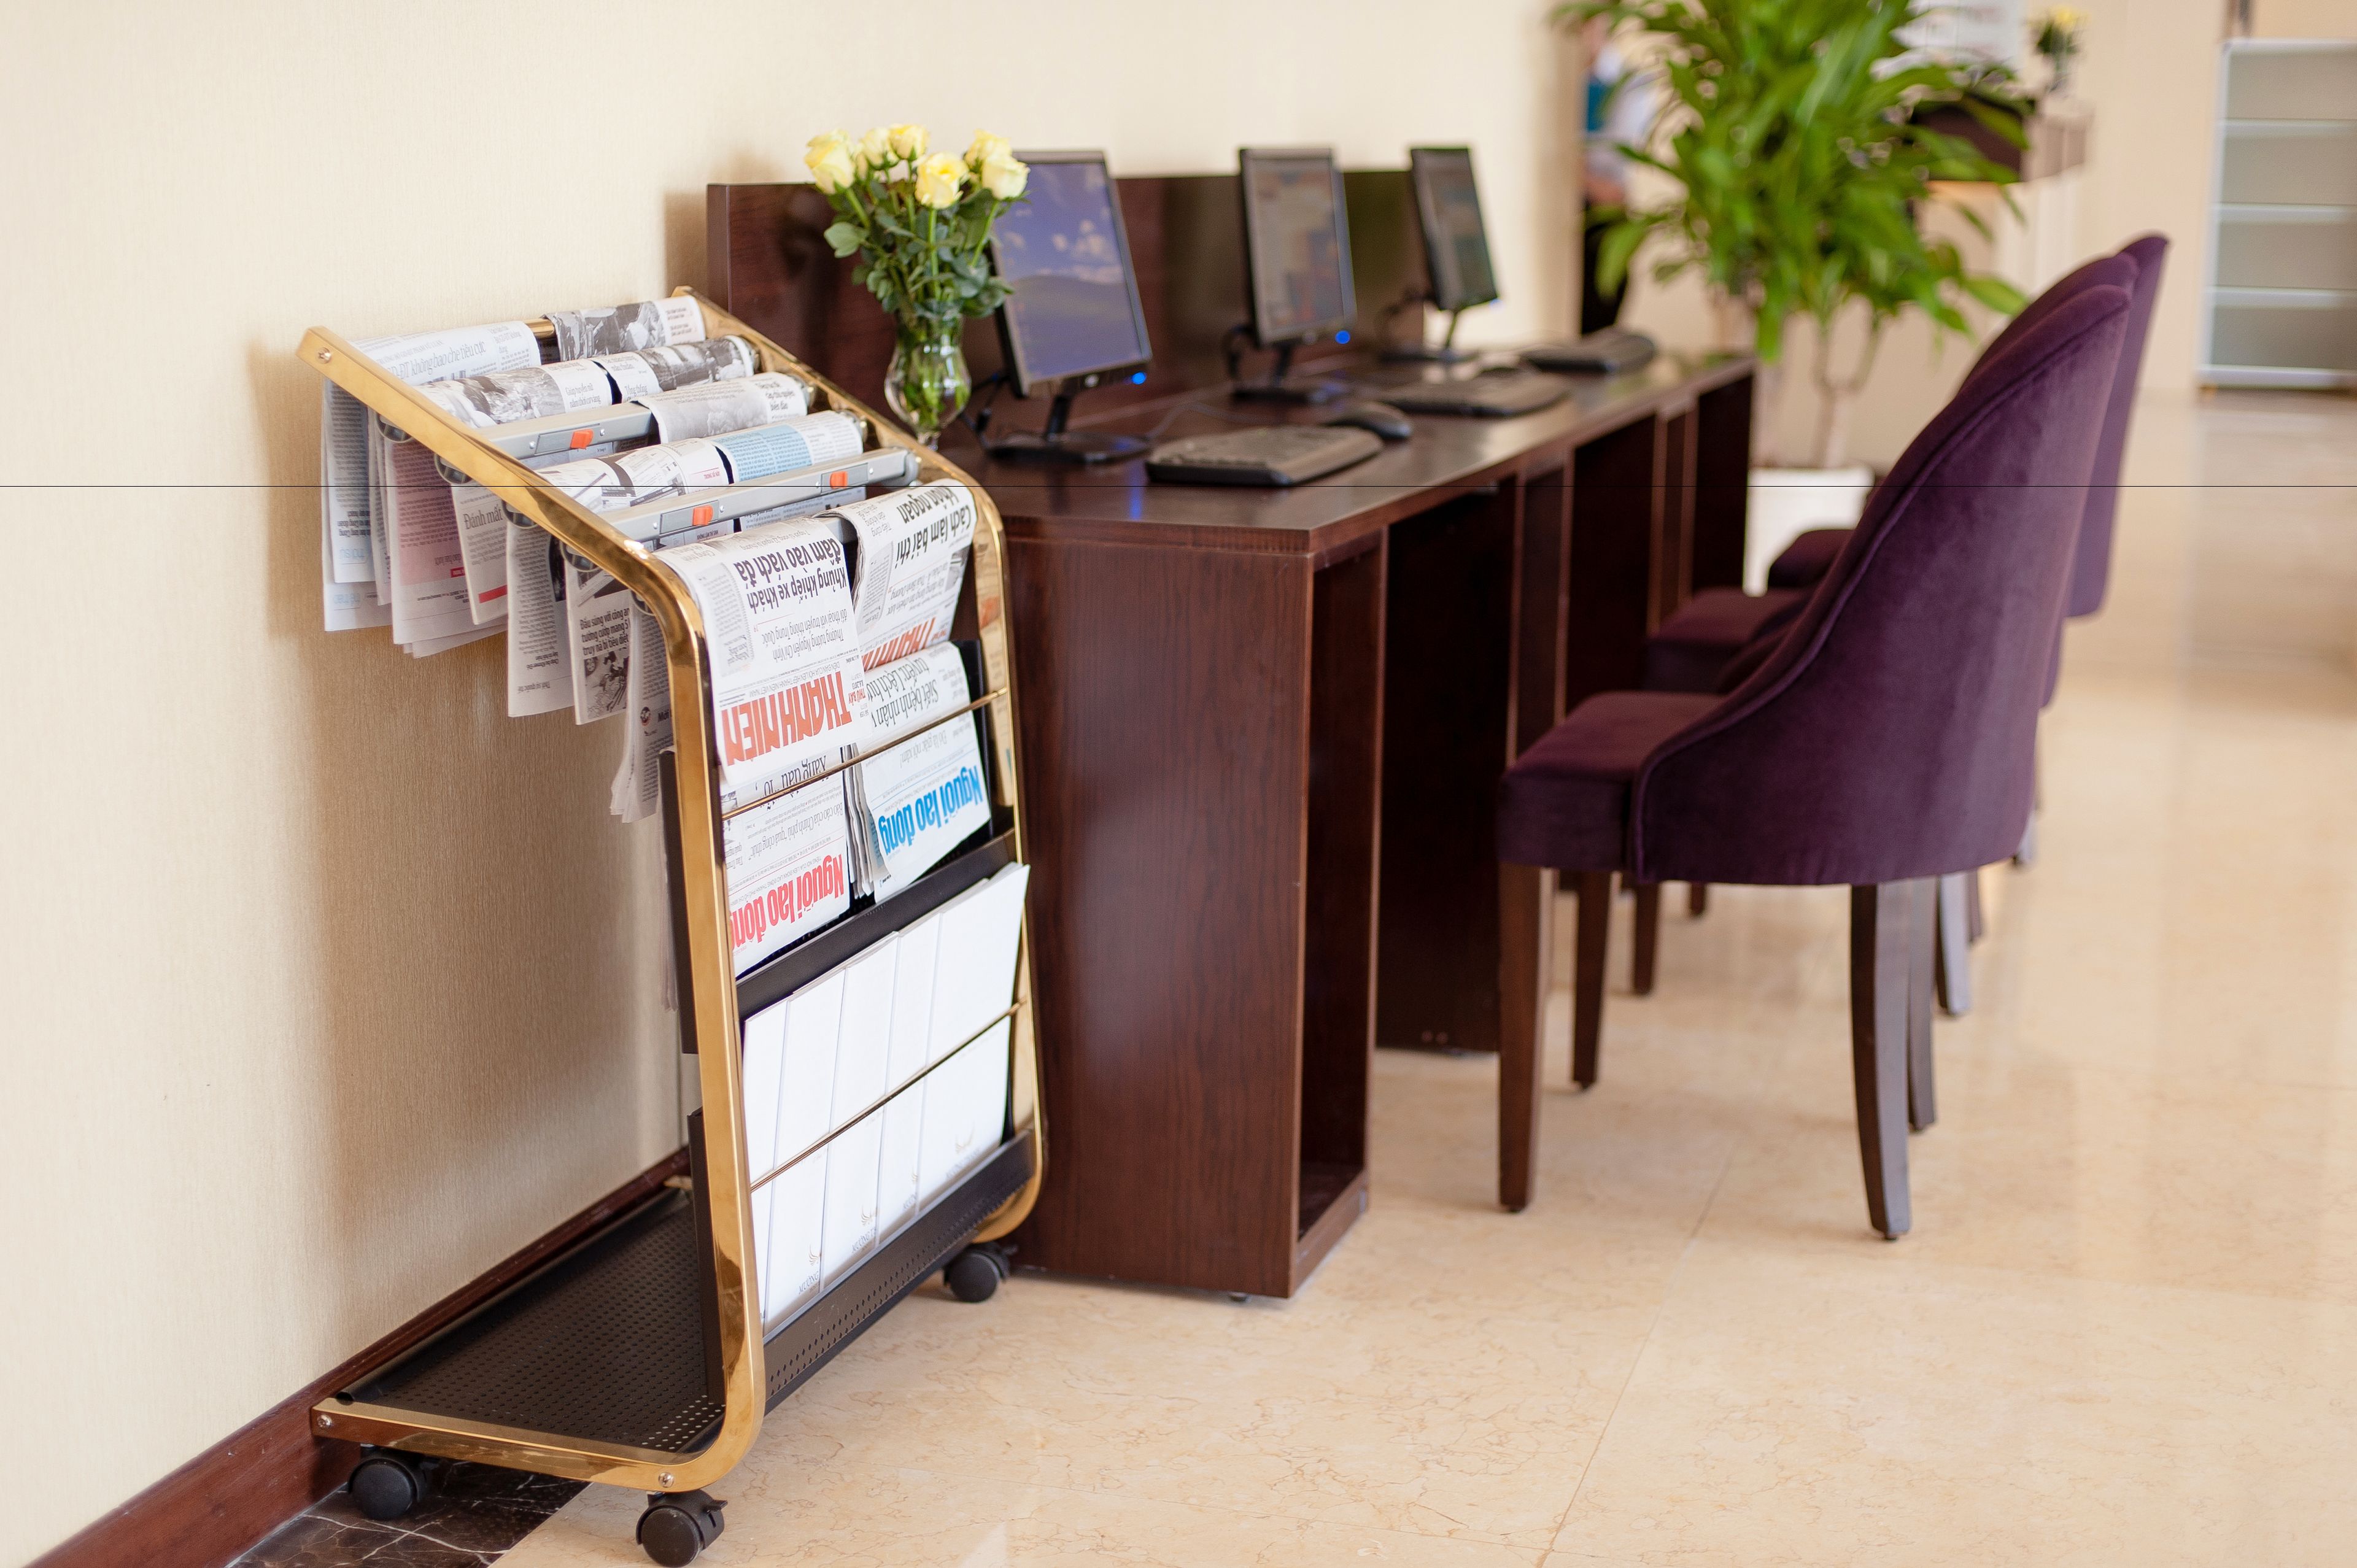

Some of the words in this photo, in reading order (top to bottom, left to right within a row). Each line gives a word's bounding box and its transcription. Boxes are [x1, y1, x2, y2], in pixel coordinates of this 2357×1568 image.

[463, 509, 487, 530] Đánh
[486, 503, 504, 524] mất
[931, 516, 948, 544] làm
[950, 505, 971, 538] Cách
[808, 538, 842, 566] đâm
[894, 537, 911, 570] thi
[911, 527, 928, 560] bài
[753, 552, 789, 584] vách
[785, 545, 813, 573] vào
[733, 560, 757, 589] đá
[816, 567, 847, 593] Khủng
[746, 587, 779, 614] khách
[777, 582, 791, 600] xe
[790, 575, 818, 604] khiếp
[591, 614, 605, 627] súng
[611, 608, 624, 620] công
[789, 621, 805, 639] thông
[820, 614, 829, 629] với
[828, 610, 840, 627] thoại
[761, 630, 776, 648] Quốc
[775, 626, 791, 640] Trung
[811, 633, 826, 649] tướng
[826, 628, 844, 642] Thượng
[772, 644, 784, 663] Vịnh
[783, 644, 793, 660] Chí
[792, 636, 811, 658] Nguyễn
[777, 671, 852, 747] THANH
[873, 699, 900, 727] nhân
[899, 687, 923, 719] bệnh
[721, 693, 780, 767] NIÊN
[939, 765, 983, 824] Người
[814, 813, 823, 827] của
[823, 809, 834, 821] cáo
[834, 802, 843, 816] Báo
[915, 789, 942, 830] lao
[788, 819, 799, 841] phủ
[799, 817, 815, 836] Chính
[878, 804, 916, 855] động
[796, 854, 845, 919] Người
[767, 879, 795, 926] lao
